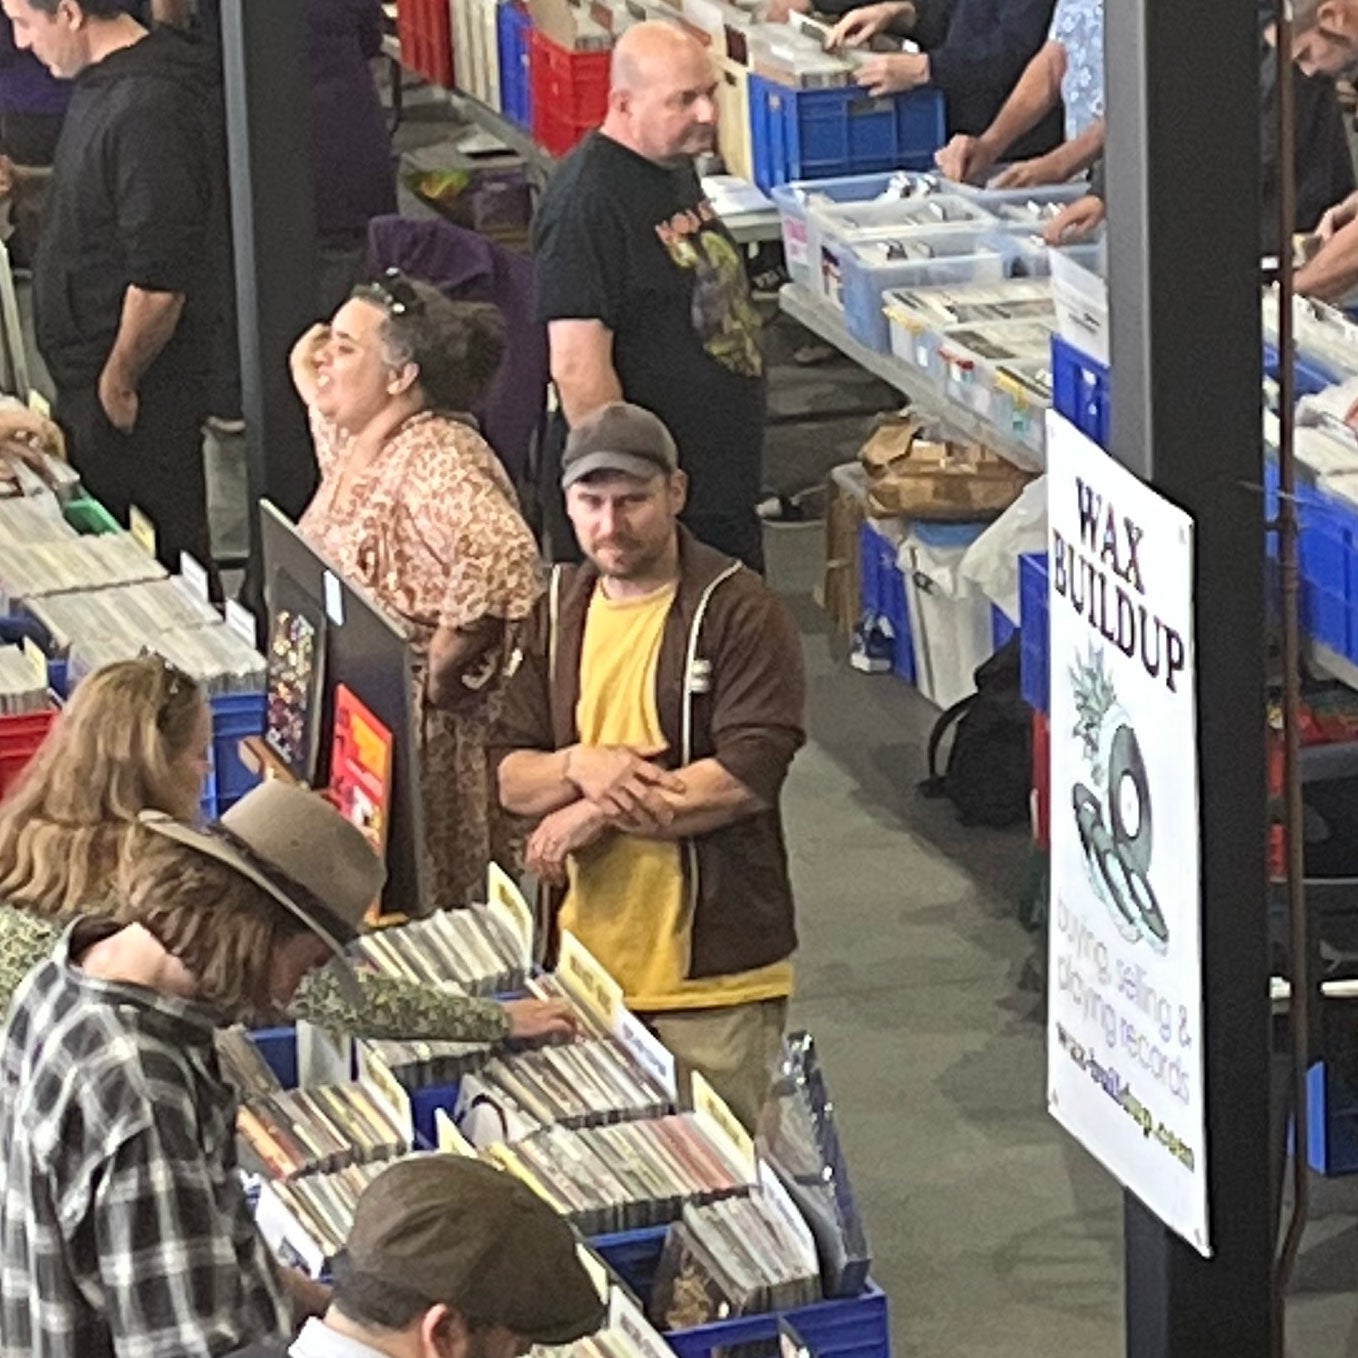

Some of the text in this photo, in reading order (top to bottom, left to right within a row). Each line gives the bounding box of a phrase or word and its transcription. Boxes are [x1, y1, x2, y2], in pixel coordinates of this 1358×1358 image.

[1075, 475, 1146, 595] WAX
[1052, 526, 1186, 694] BUILDUP
[1120, 1016, 1191, 1106] records
[1178, 1003, 1193, 1049] &
